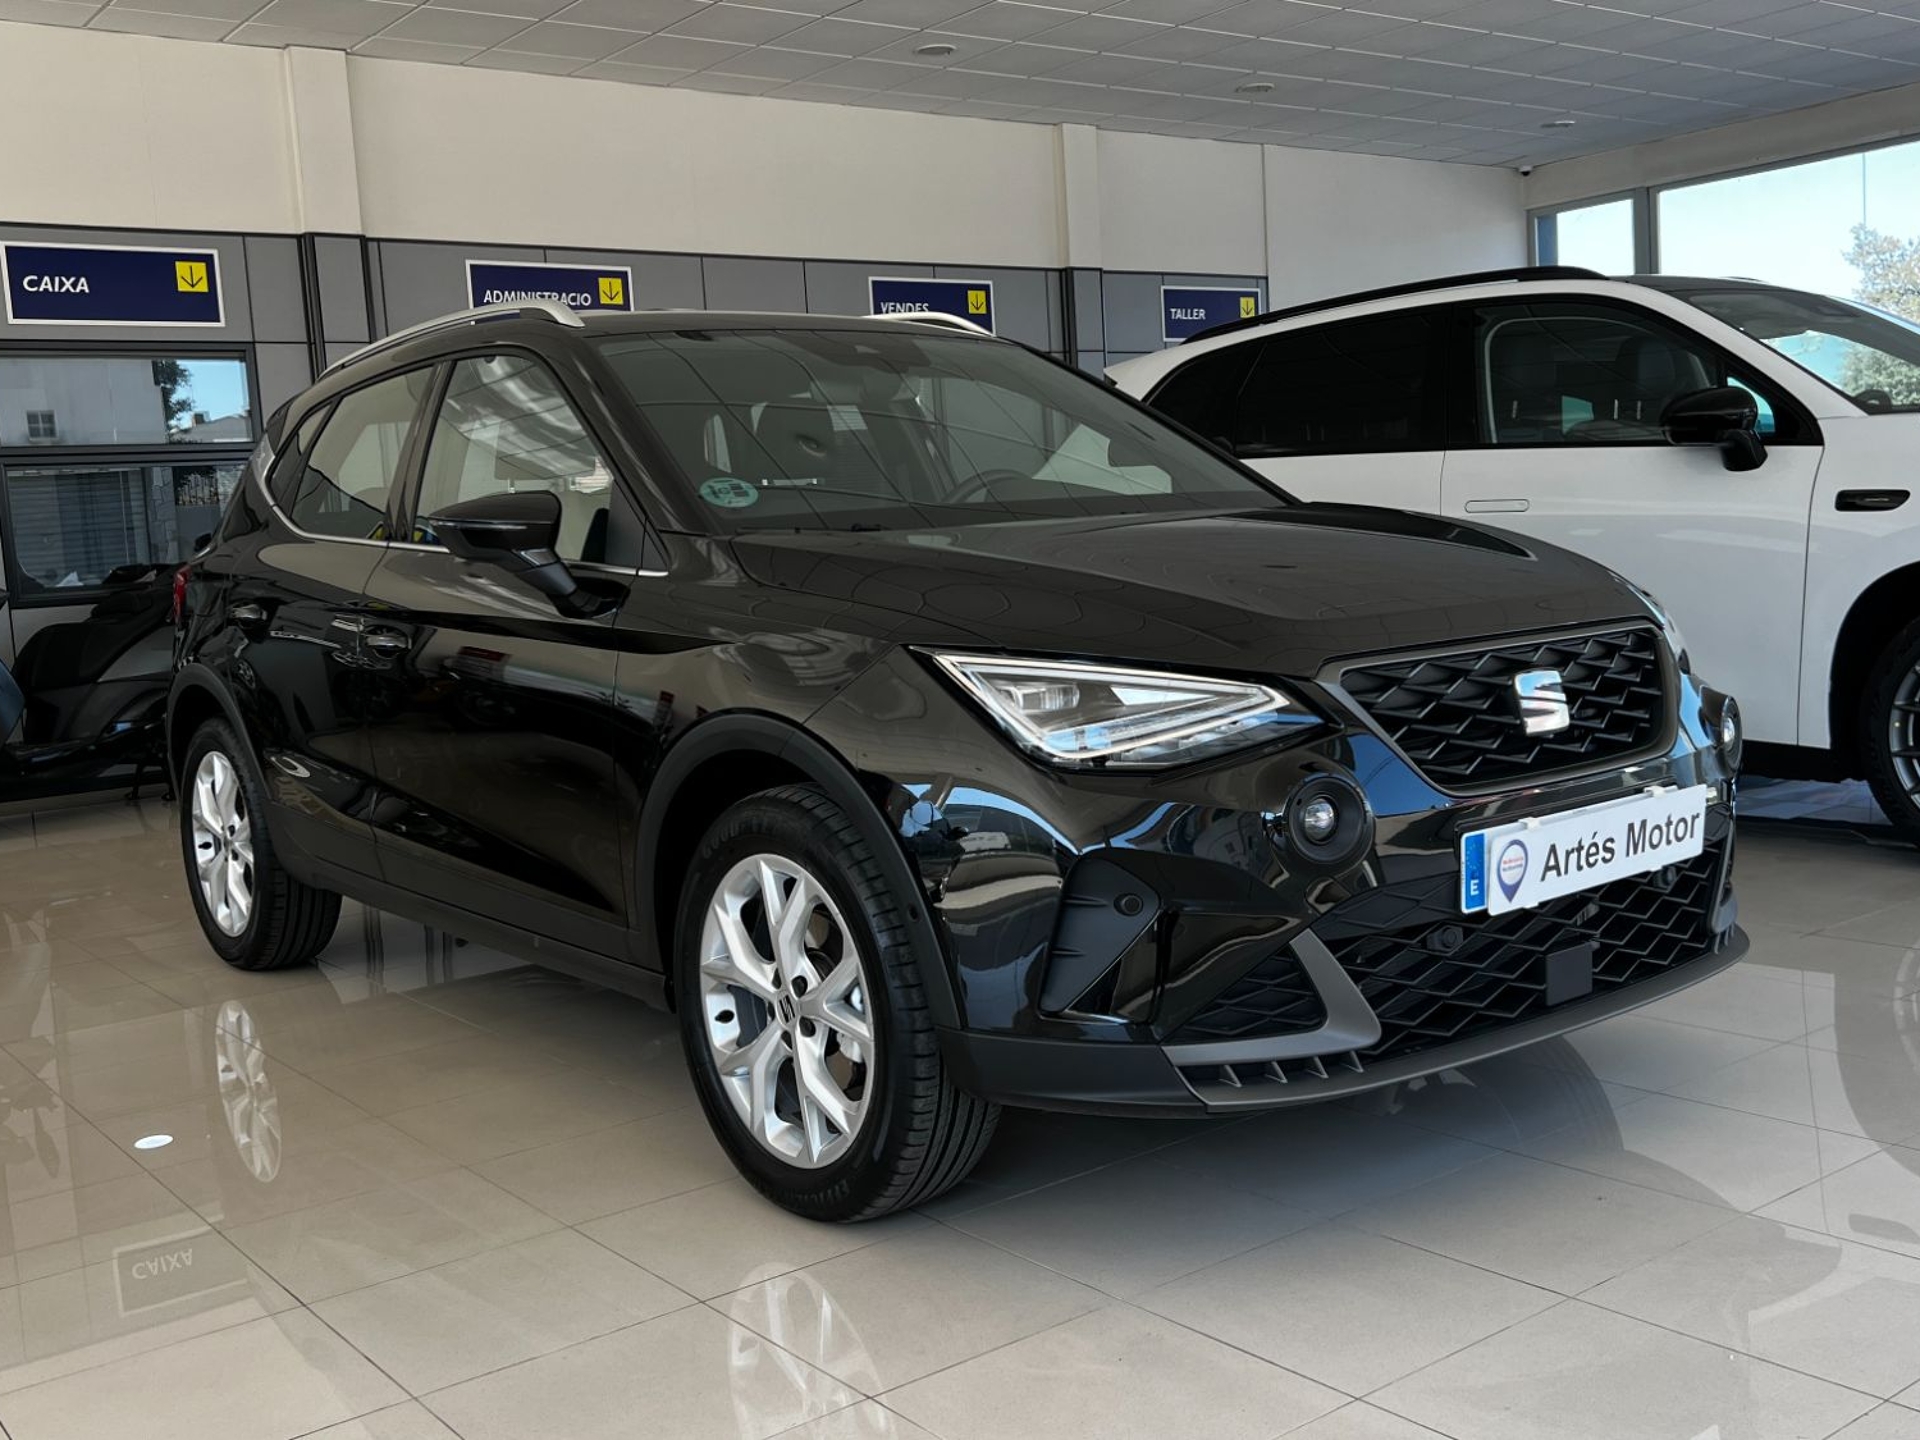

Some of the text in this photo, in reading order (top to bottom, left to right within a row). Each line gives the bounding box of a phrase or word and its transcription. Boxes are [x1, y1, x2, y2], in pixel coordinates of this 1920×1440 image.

[22, 275, 90, 293] CAIXA
[880, 301, 930, 313] VENDES
[1170, 308, 1206, 320] TALLER
[1540, 812, 1701, 882] Artés Motor
[1470, 879, 1480, 896] E
